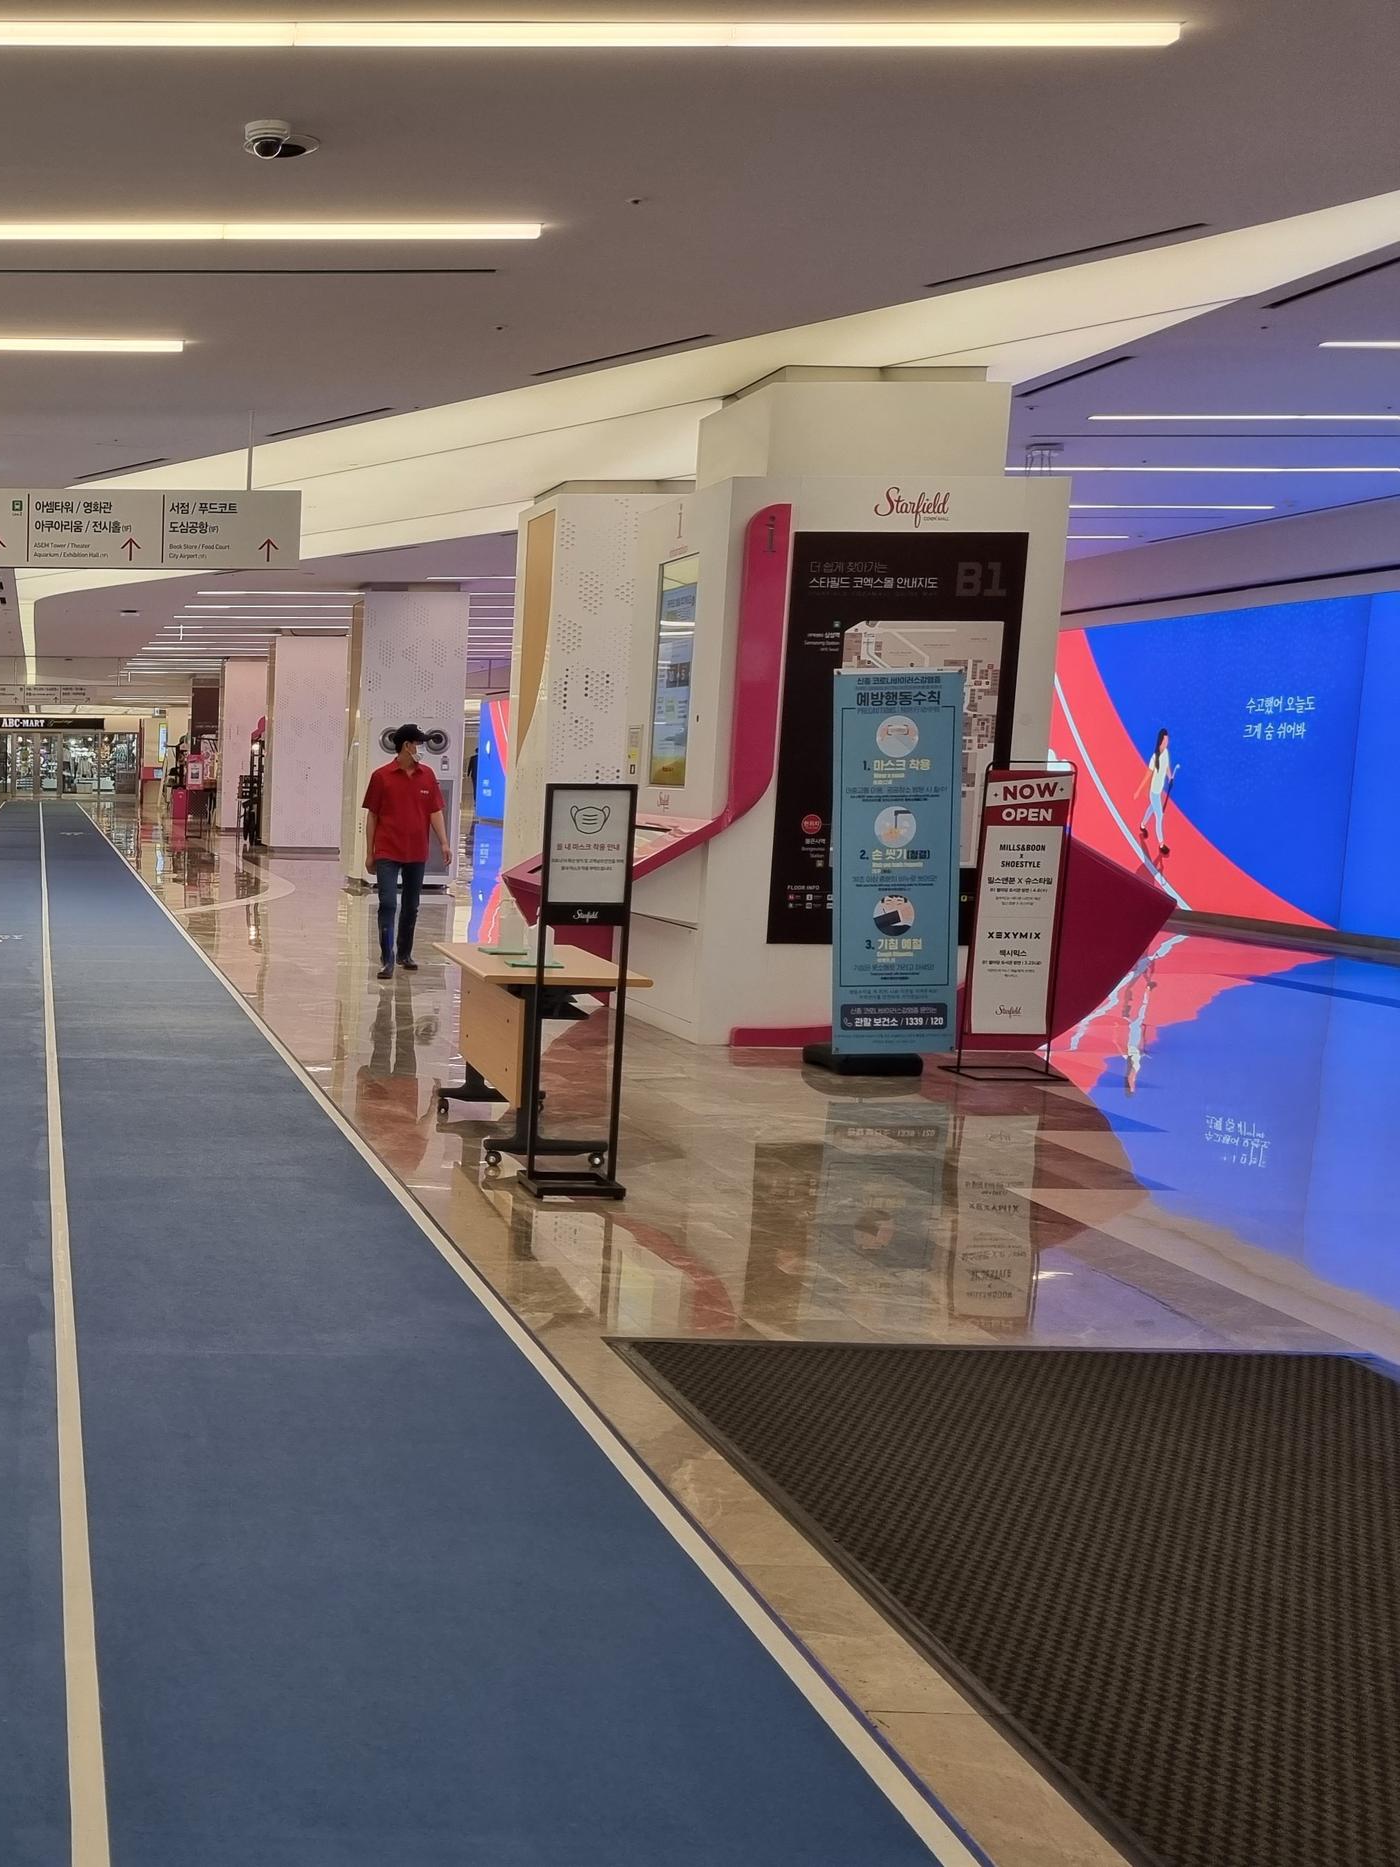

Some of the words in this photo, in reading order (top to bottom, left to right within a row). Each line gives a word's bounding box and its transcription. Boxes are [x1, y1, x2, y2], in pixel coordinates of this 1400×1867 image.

[35, 500, 74, 514] 아셈타워
[83, 500, 112, 514] 영화관
[169, 502, 190, 515] 서점
[198, 502, 238, 515] 푸드코트
[873, 486, 951, 528] Starfield
[34, 520, 83, 533] 아쿠아리움
[168, 552, 179, 560] City
[179, 552, 198, 560] Airport
[808, 577, 850, 589] 스타필드
[853, 577, 894, 589] 코엑스몰
[896, 577, 938, 589] 안내지도
[955, 561, 1007, 597] B1
[856, 690, 941, 706] 예방행동수칙
[1246, 695, 1283, 714] 수고했어
[1284, 695, 1316, 713] 오늘도
[1, 718, 45, 728] ABC-MART
[1243, 722, 1262, 740] 크게
[1264, 722, 1274, 740] 숨
[1277, 721, 1307, 740] 쉬어봐
[873, 759, 906, 771] 마스크
[1002, 781, 1058, 801] NOW
[1001, 807, 1053, 821] OPEN
[999, 843, 1046, 851] MILLS&BOON
[860, 849, 869, 860] 2.
[872, 849, 882, 860] 손
[1000, 860, 1041, 868] SHOESTYLE
[1024, 877, 1053, 885] 슈스타일
[572, 908, 599, 923] Starfield
[865, 939, 875, 950] 3.
[877, 938, 899, 950] 기침
[995, 1005, 1022, 1019] Starfield
[873, 1017, 899, 1027] 보건소
[905, 1017, 924, 1026] 1339
[930, 1016, 944, 1026] 120
